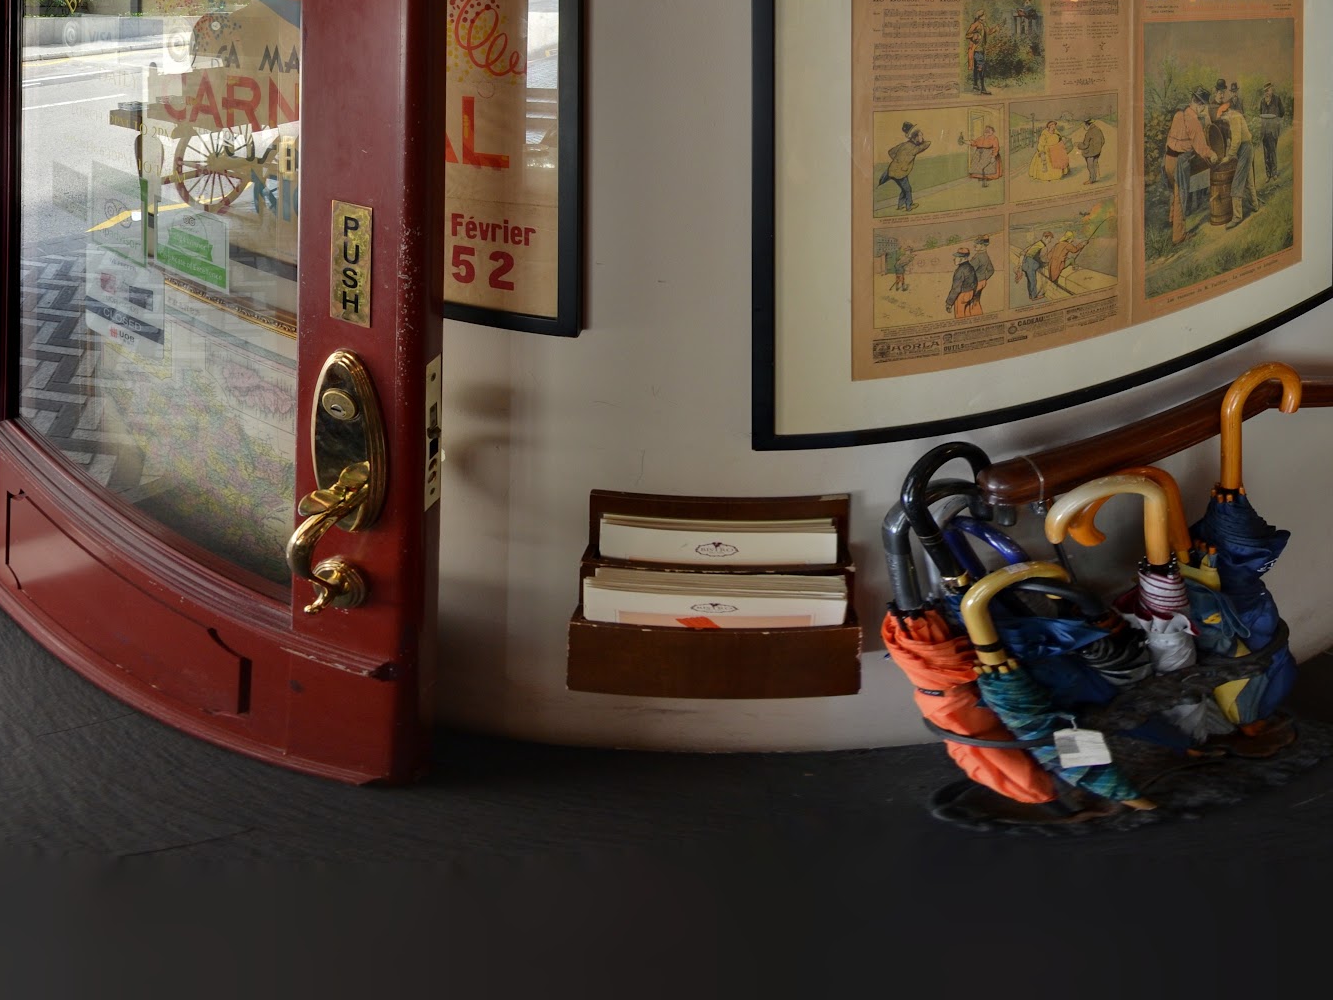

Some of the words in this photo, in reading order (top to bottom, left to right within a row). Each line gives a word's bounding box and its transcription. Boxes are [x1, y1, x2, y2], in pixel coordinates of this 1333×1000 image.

[451, 213, 537, 247] Février
[342, 216, 361, 314] PUSH
[103, 307, 143, 332] CLOSED
[1017, 316, 1044, 327] CADEAU
[119, 330, 136, 343] UOB
